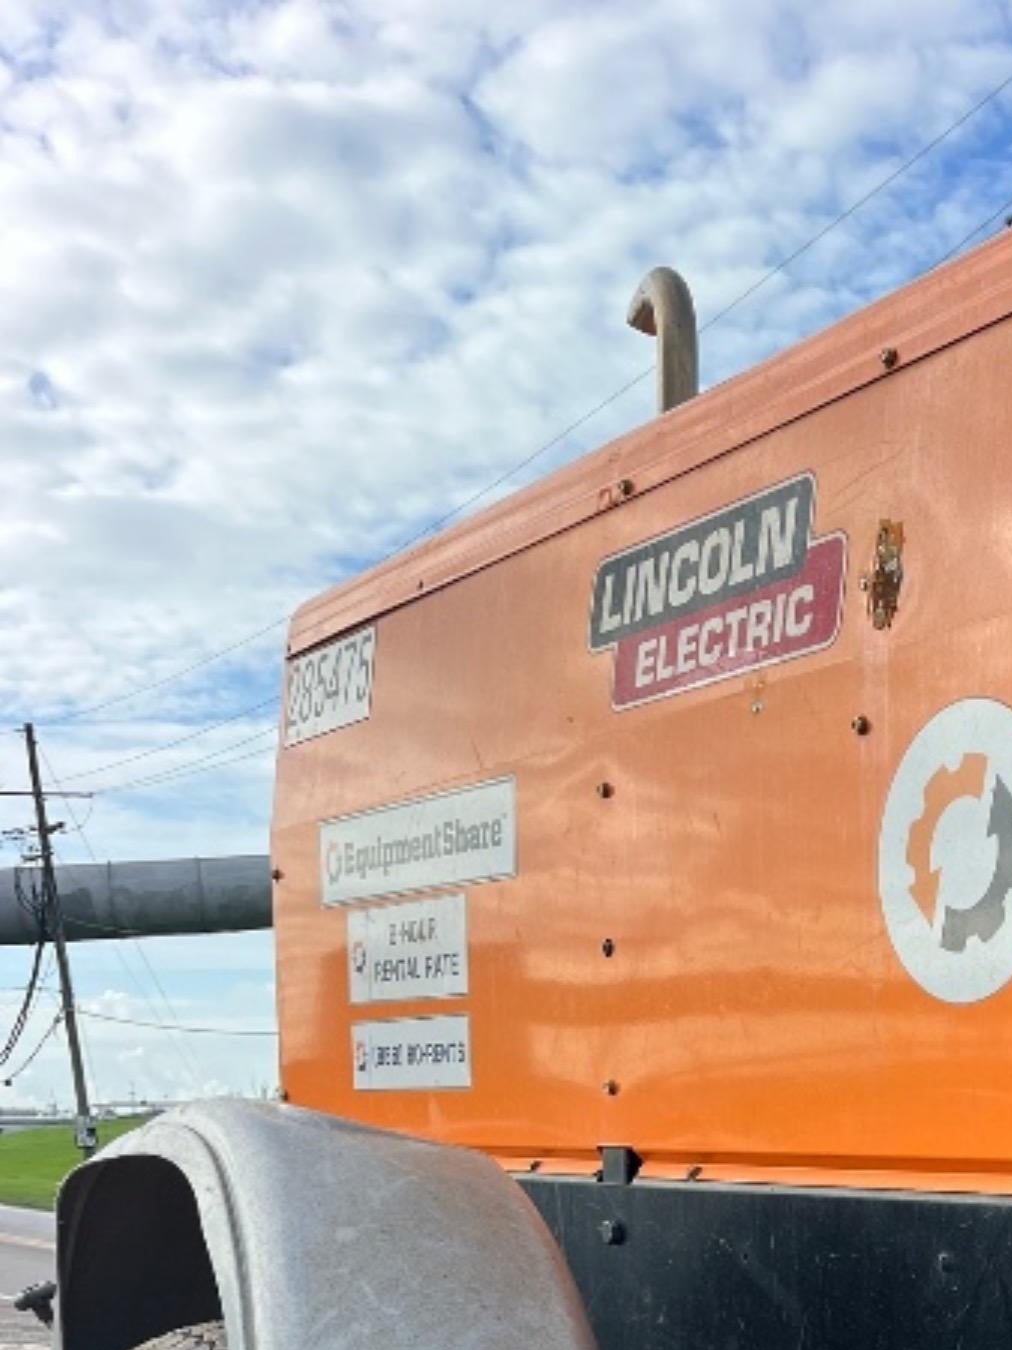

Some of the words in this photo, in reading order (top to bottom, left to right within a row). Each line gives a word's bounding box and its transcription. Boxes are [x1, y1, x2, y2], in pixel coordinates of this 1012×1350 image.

[600, 496, 798, 635] LINCOLN
[287, 631, 373, 726] 285475
[634, 584, 815, 689] ELECTRIC
[343, 817, 502, 879] EquipmentShare
[374, 957, 421, 982] RENTAL
[425, 952, 459, 978] RATE
